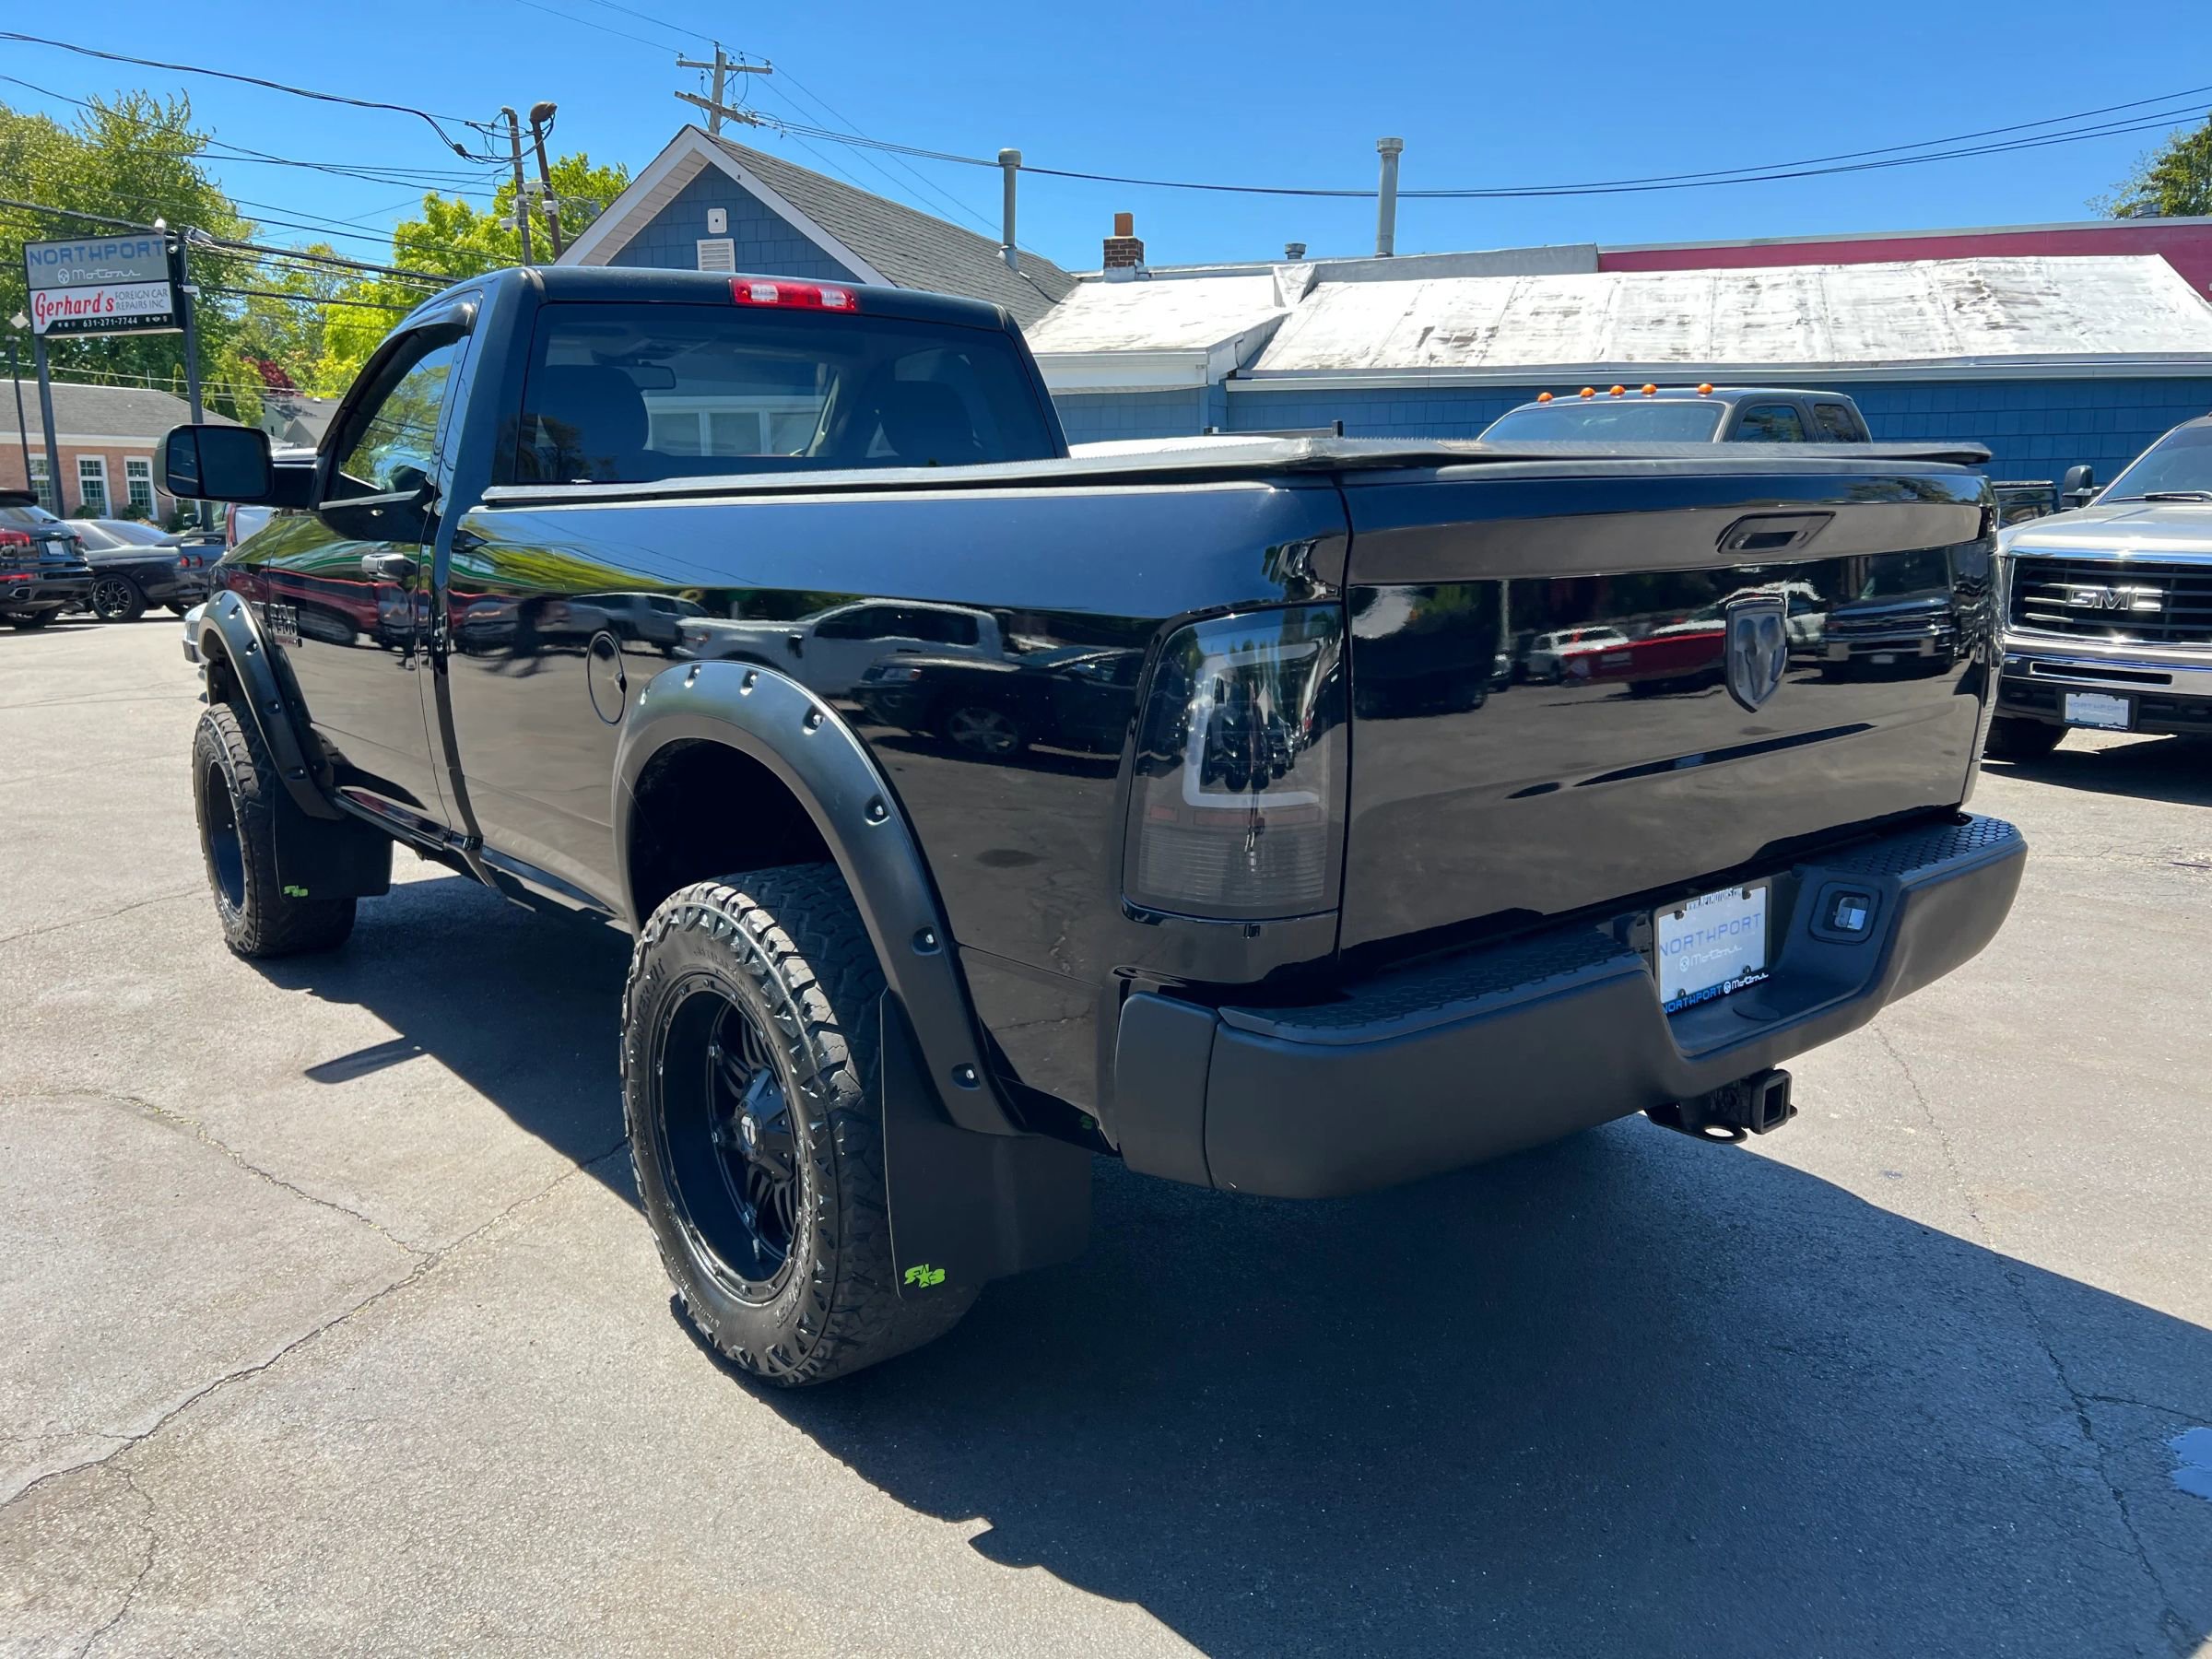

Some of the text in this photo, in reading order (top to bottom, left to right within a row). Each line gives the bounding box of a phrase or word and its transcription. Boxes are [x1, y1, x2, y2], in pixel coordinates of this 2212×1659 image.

[29, 240, 163, 266] NORTHPORT
[115, 288, 168, 300] FOREIGN CAR
[115, 299, 164, 311] REPAIRS INC
[35, 290, 114, 325] Gerhard's
[83, 316, 138, 328] 631-271-7744
[2065, 587, 2163, 612] GMC
[1660, 912, 1761, 957] NORTHPORT
[1663, 984, 1723, 1014] NORTHPORT
